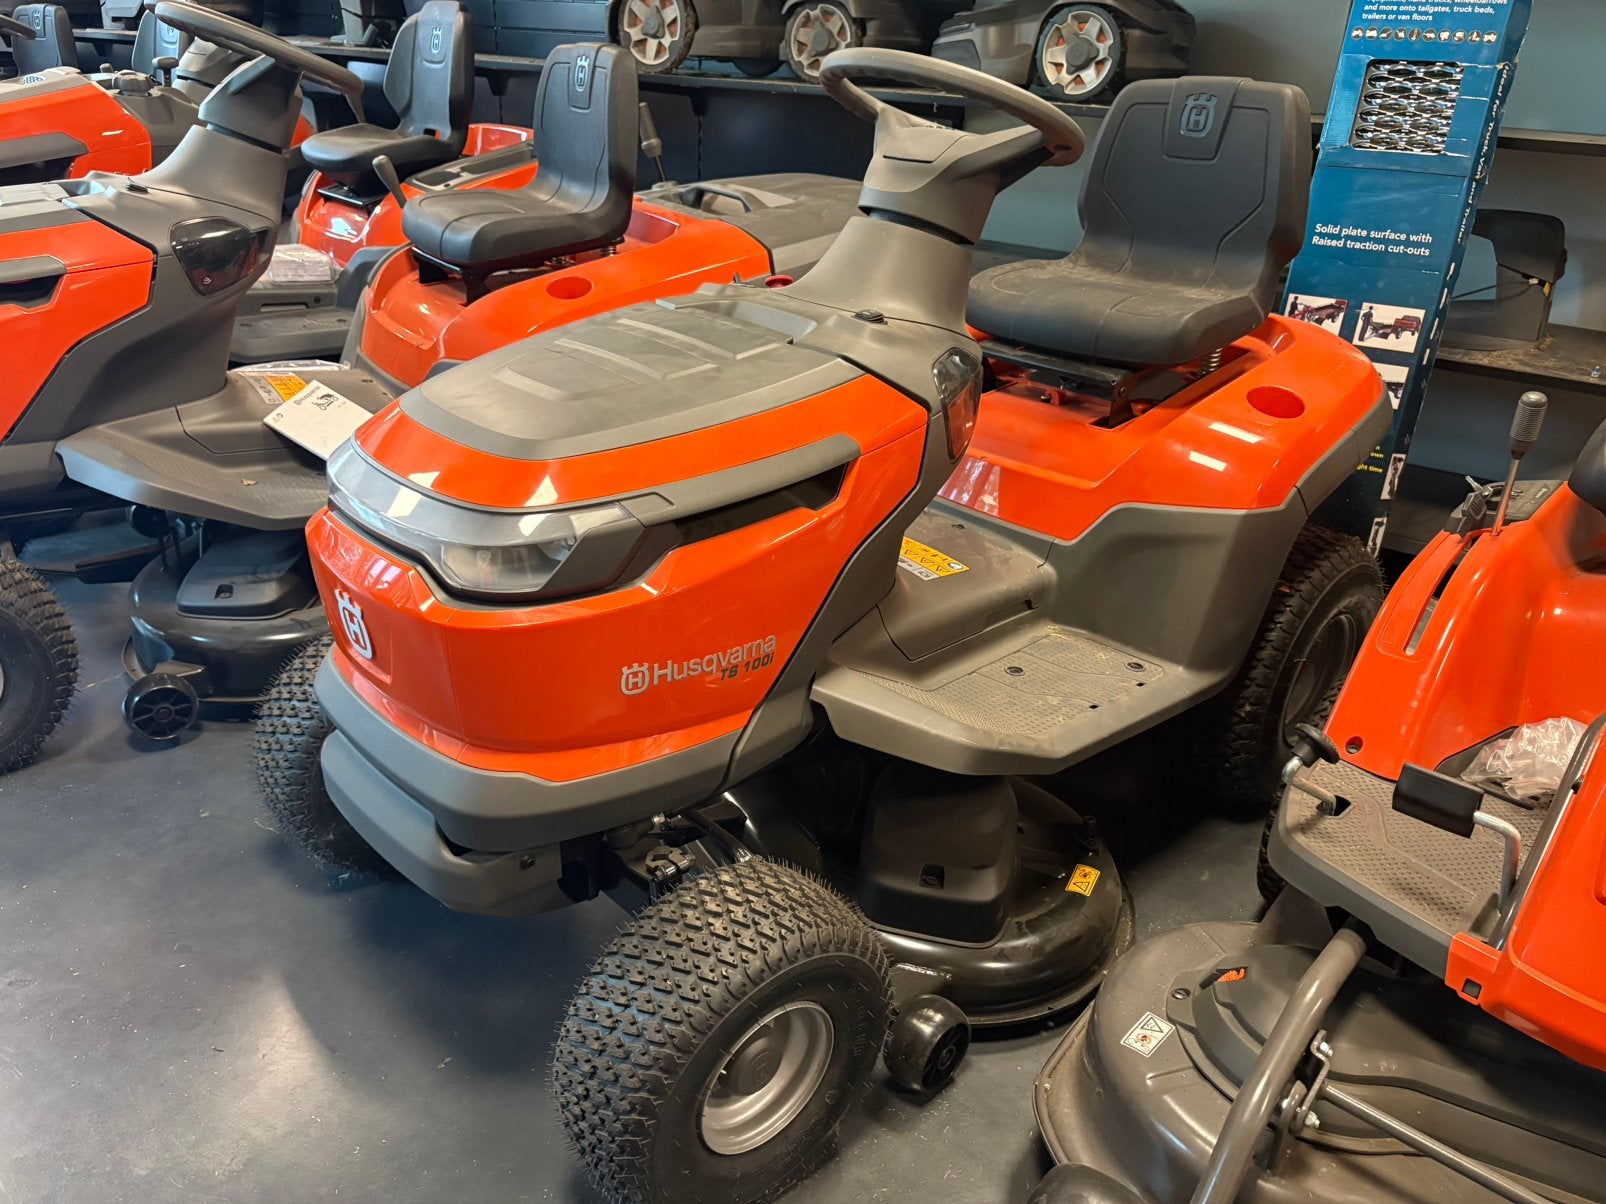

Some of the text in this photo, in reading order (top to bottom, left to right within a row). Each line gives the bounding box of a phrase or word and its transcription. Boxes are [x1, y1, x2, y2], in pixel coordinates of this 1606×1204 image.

[1362, 12, 1387, 20] trailers
[1411, 12, 1433, 21] floors
[1363, 3, 1379, 11] and
[1399, 4, 1416, 12] onto
[1418, 4, 1451, 14] tailgates,
[1453, 5, 1473, 13] truck
[1474, 5, 1496, 15] beds,
[1496, 64, 1509, 97] Ideal
[1491, 99, 1500, 118] for
[1467, 180, 1477, 204] and
[1314, 223, 1433, 243] Solid plate surface with
[1458, 207, 1470, 244] Trailer
[1311, 235, 1431, 256] Raised traction cut-outs
[653, 634, 777, 686] Husqvarna
[720, 651, 775, 681] TS 100i
